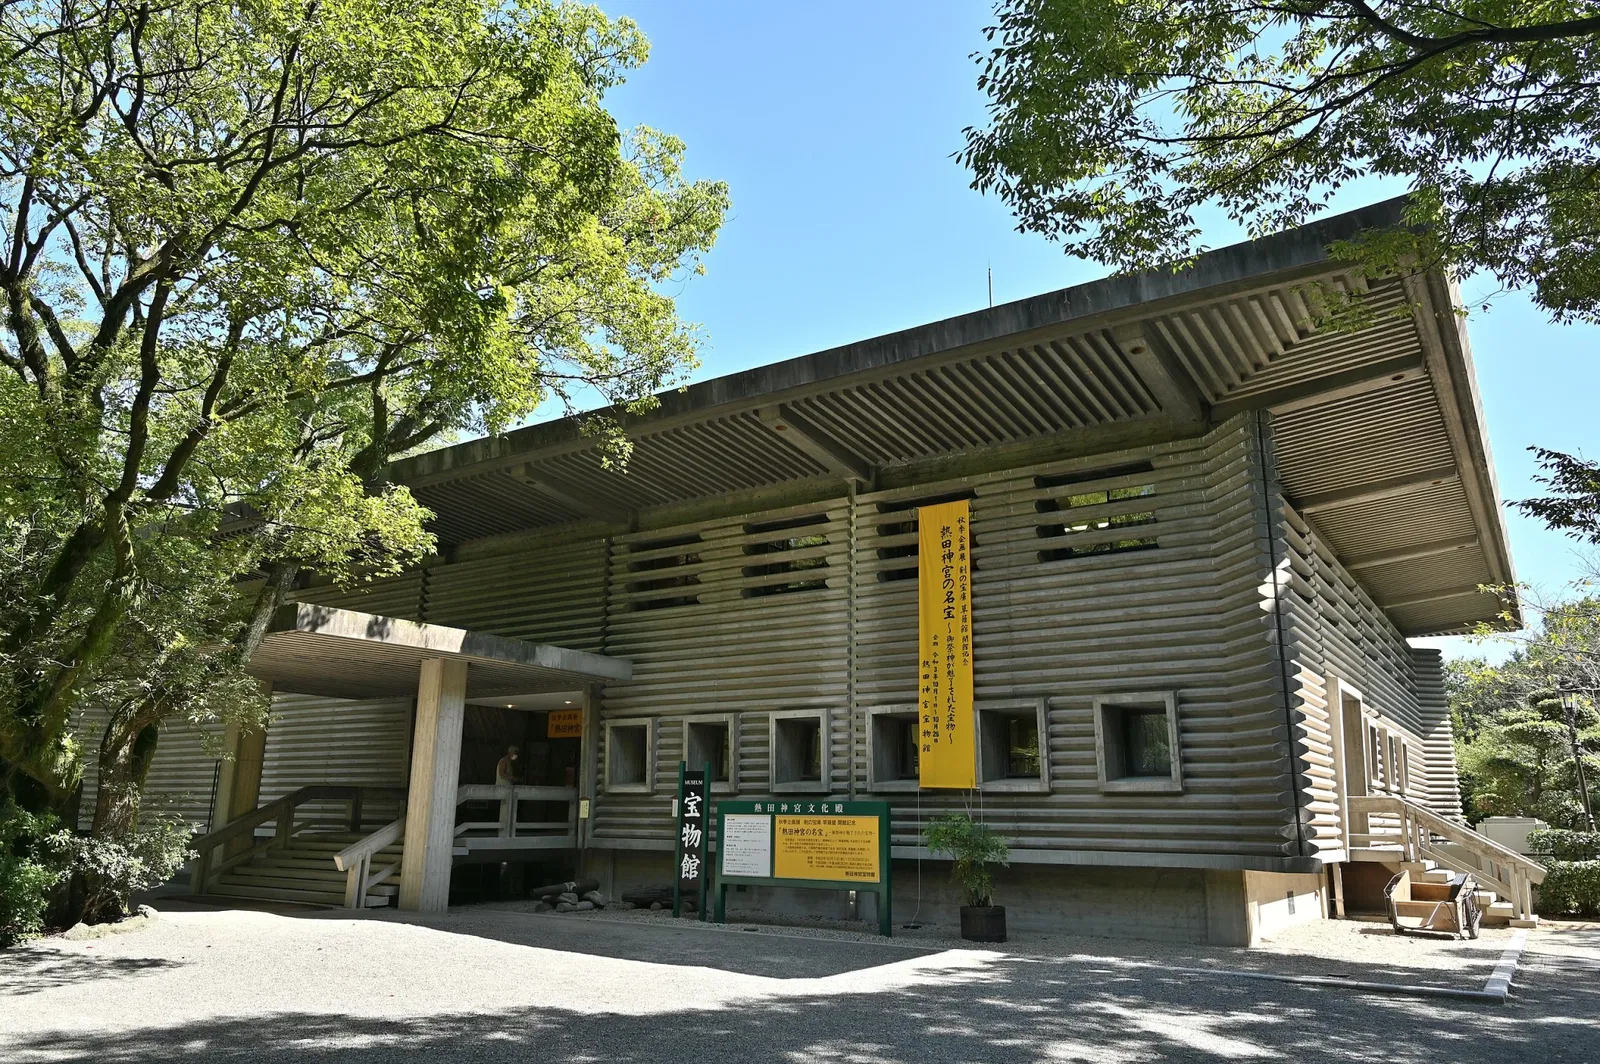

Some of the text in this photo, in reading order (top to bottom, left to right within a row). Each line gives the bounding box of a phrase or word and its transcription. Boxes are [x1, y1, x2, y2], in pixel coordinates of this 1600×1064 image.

[940, 525, 956, 620] 熱田神宮の名宝
[922, 660, 932, 753] 熱田神宮宝物館
[681, 791, 703, 880] 宝物館
[754, 803, 844, 813] 熱田神宮文化殿
